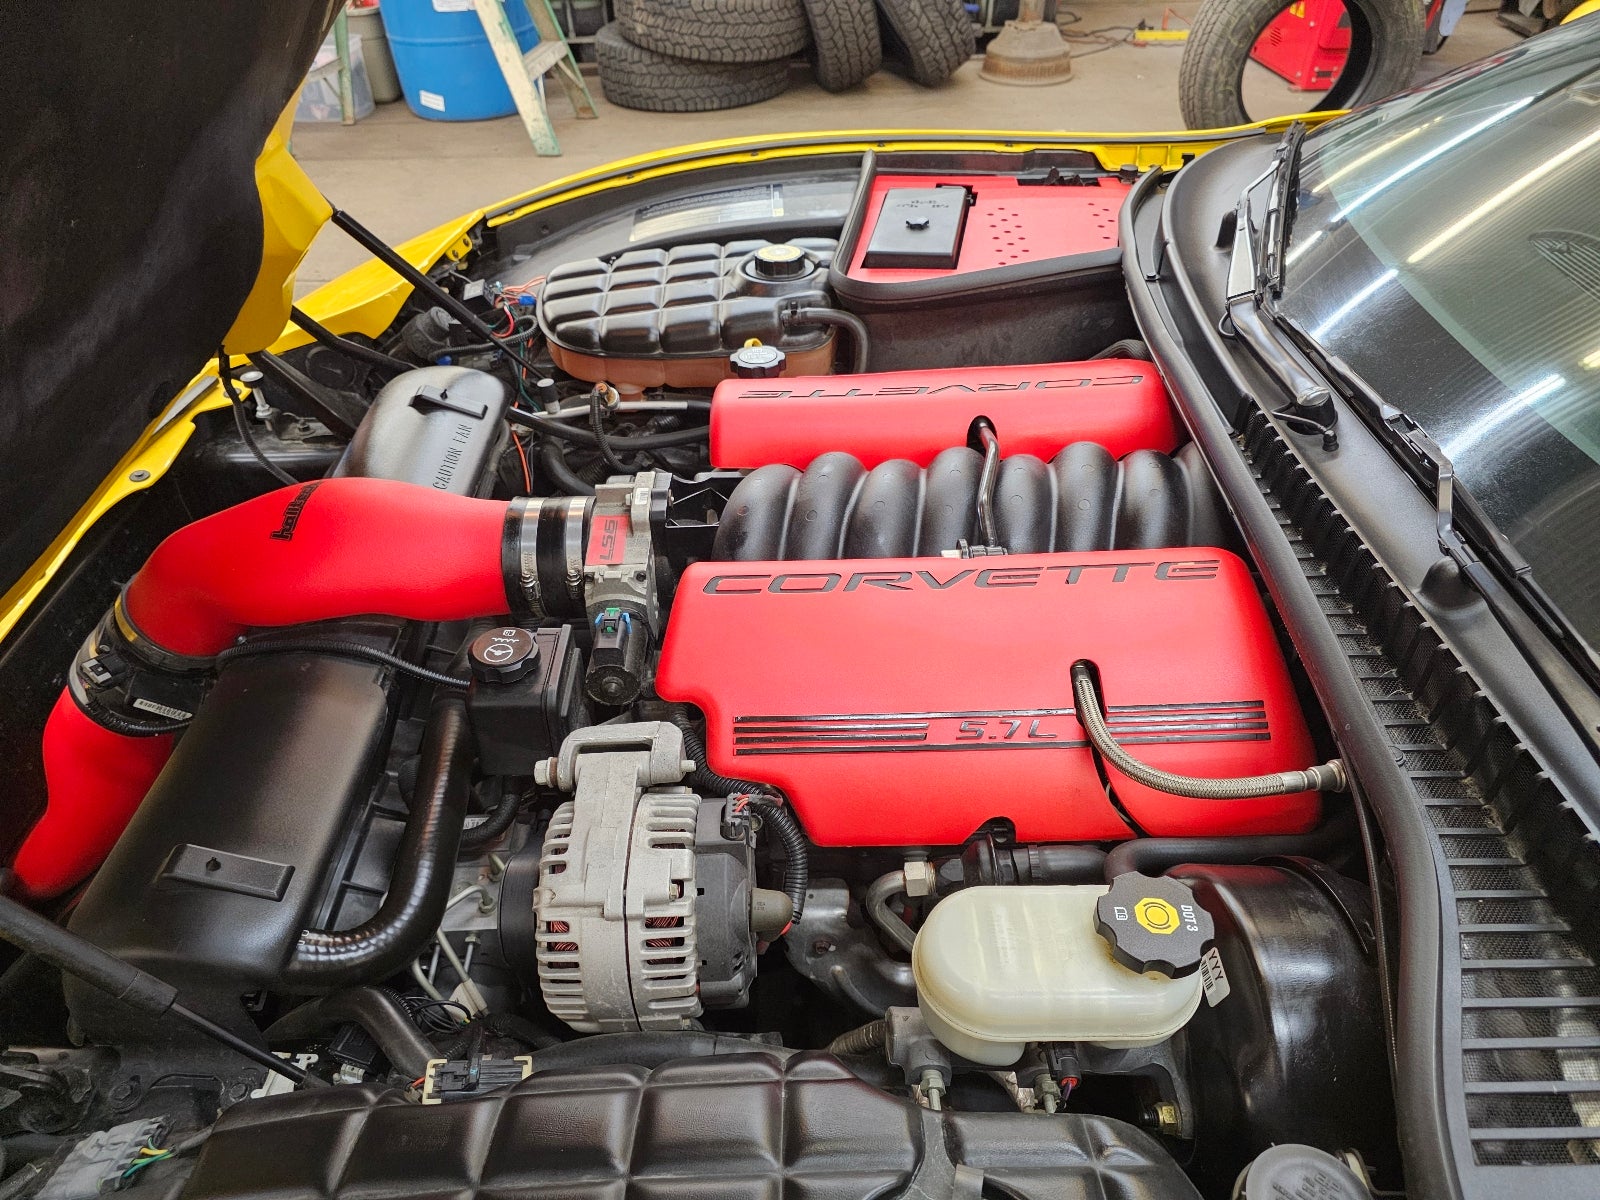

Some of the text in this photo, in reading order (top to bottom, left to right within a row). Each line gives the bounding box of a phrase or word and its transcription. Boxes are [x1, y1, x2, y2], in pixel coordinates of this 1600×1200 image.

[738, 375, 1144, 399] CORVETTE
[432, 423, 473, 490] CAUTION FAN
[599, 519, 616, 561] LS6
[702, 559, 1221, 595] CORVETTE
[955, 719, 1058, 741] 5.7L
[1181, 904, 1198, 932] DOT 3
[1209, 950, 1224, 981] YYY
